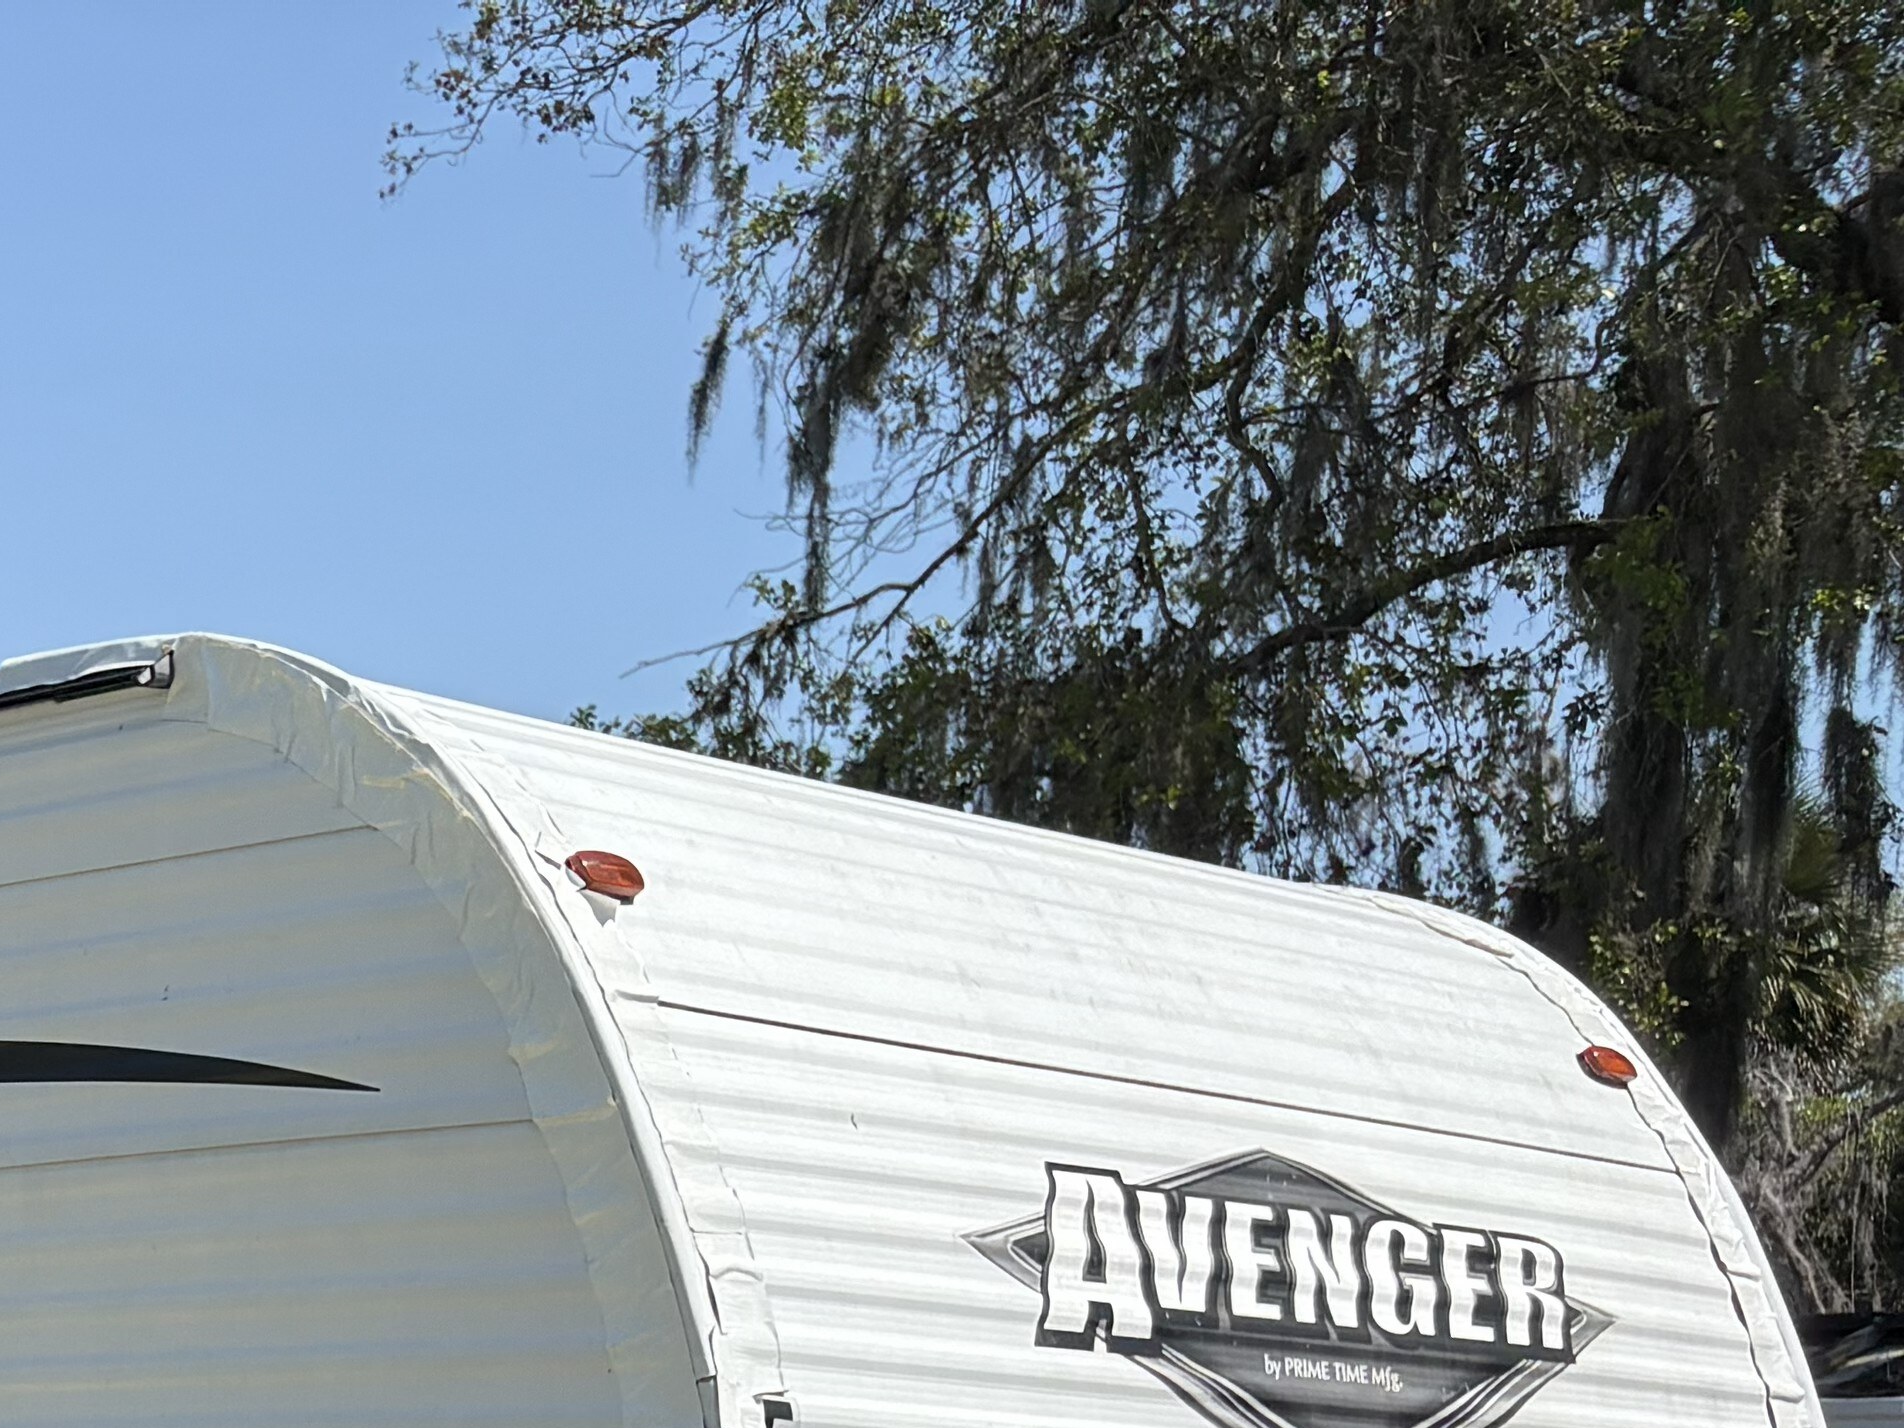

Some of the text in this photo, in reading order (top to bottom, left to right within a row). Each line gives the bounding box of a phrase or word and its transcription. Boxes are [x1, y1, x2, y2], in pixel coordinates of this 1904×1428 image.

[1034, 1161, 1575, 1363] AVENGER
[1264, 1353, 1282, 1381] by
[1284, 1357, 1331, 1381] PRIME
[1333, 1362, 1369, 1385] TIME
